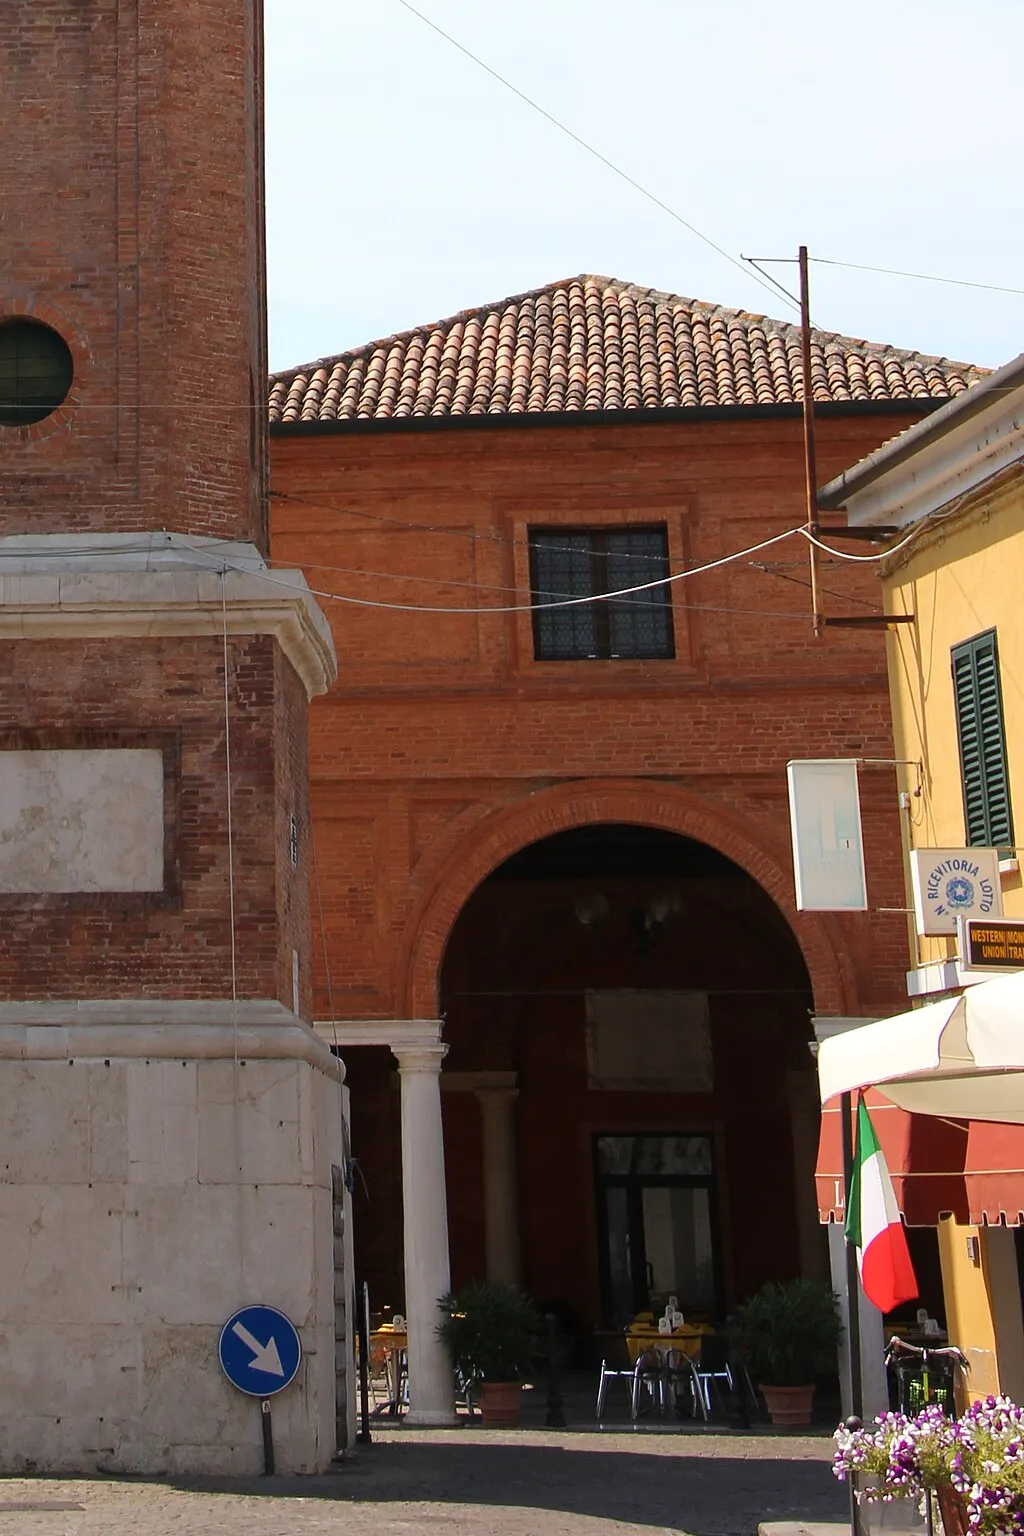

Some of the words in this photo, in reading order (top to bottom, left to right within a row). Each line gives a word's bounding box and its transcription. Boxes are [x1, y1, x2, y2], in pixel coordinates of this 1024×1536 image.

[927, 859, 980, 899] RICEVITORIA
[979, 878, 994, 912] LOTTO
[971, 929, 1005, 943] WESTERN
[982, 945, 1006, 959] UNION
